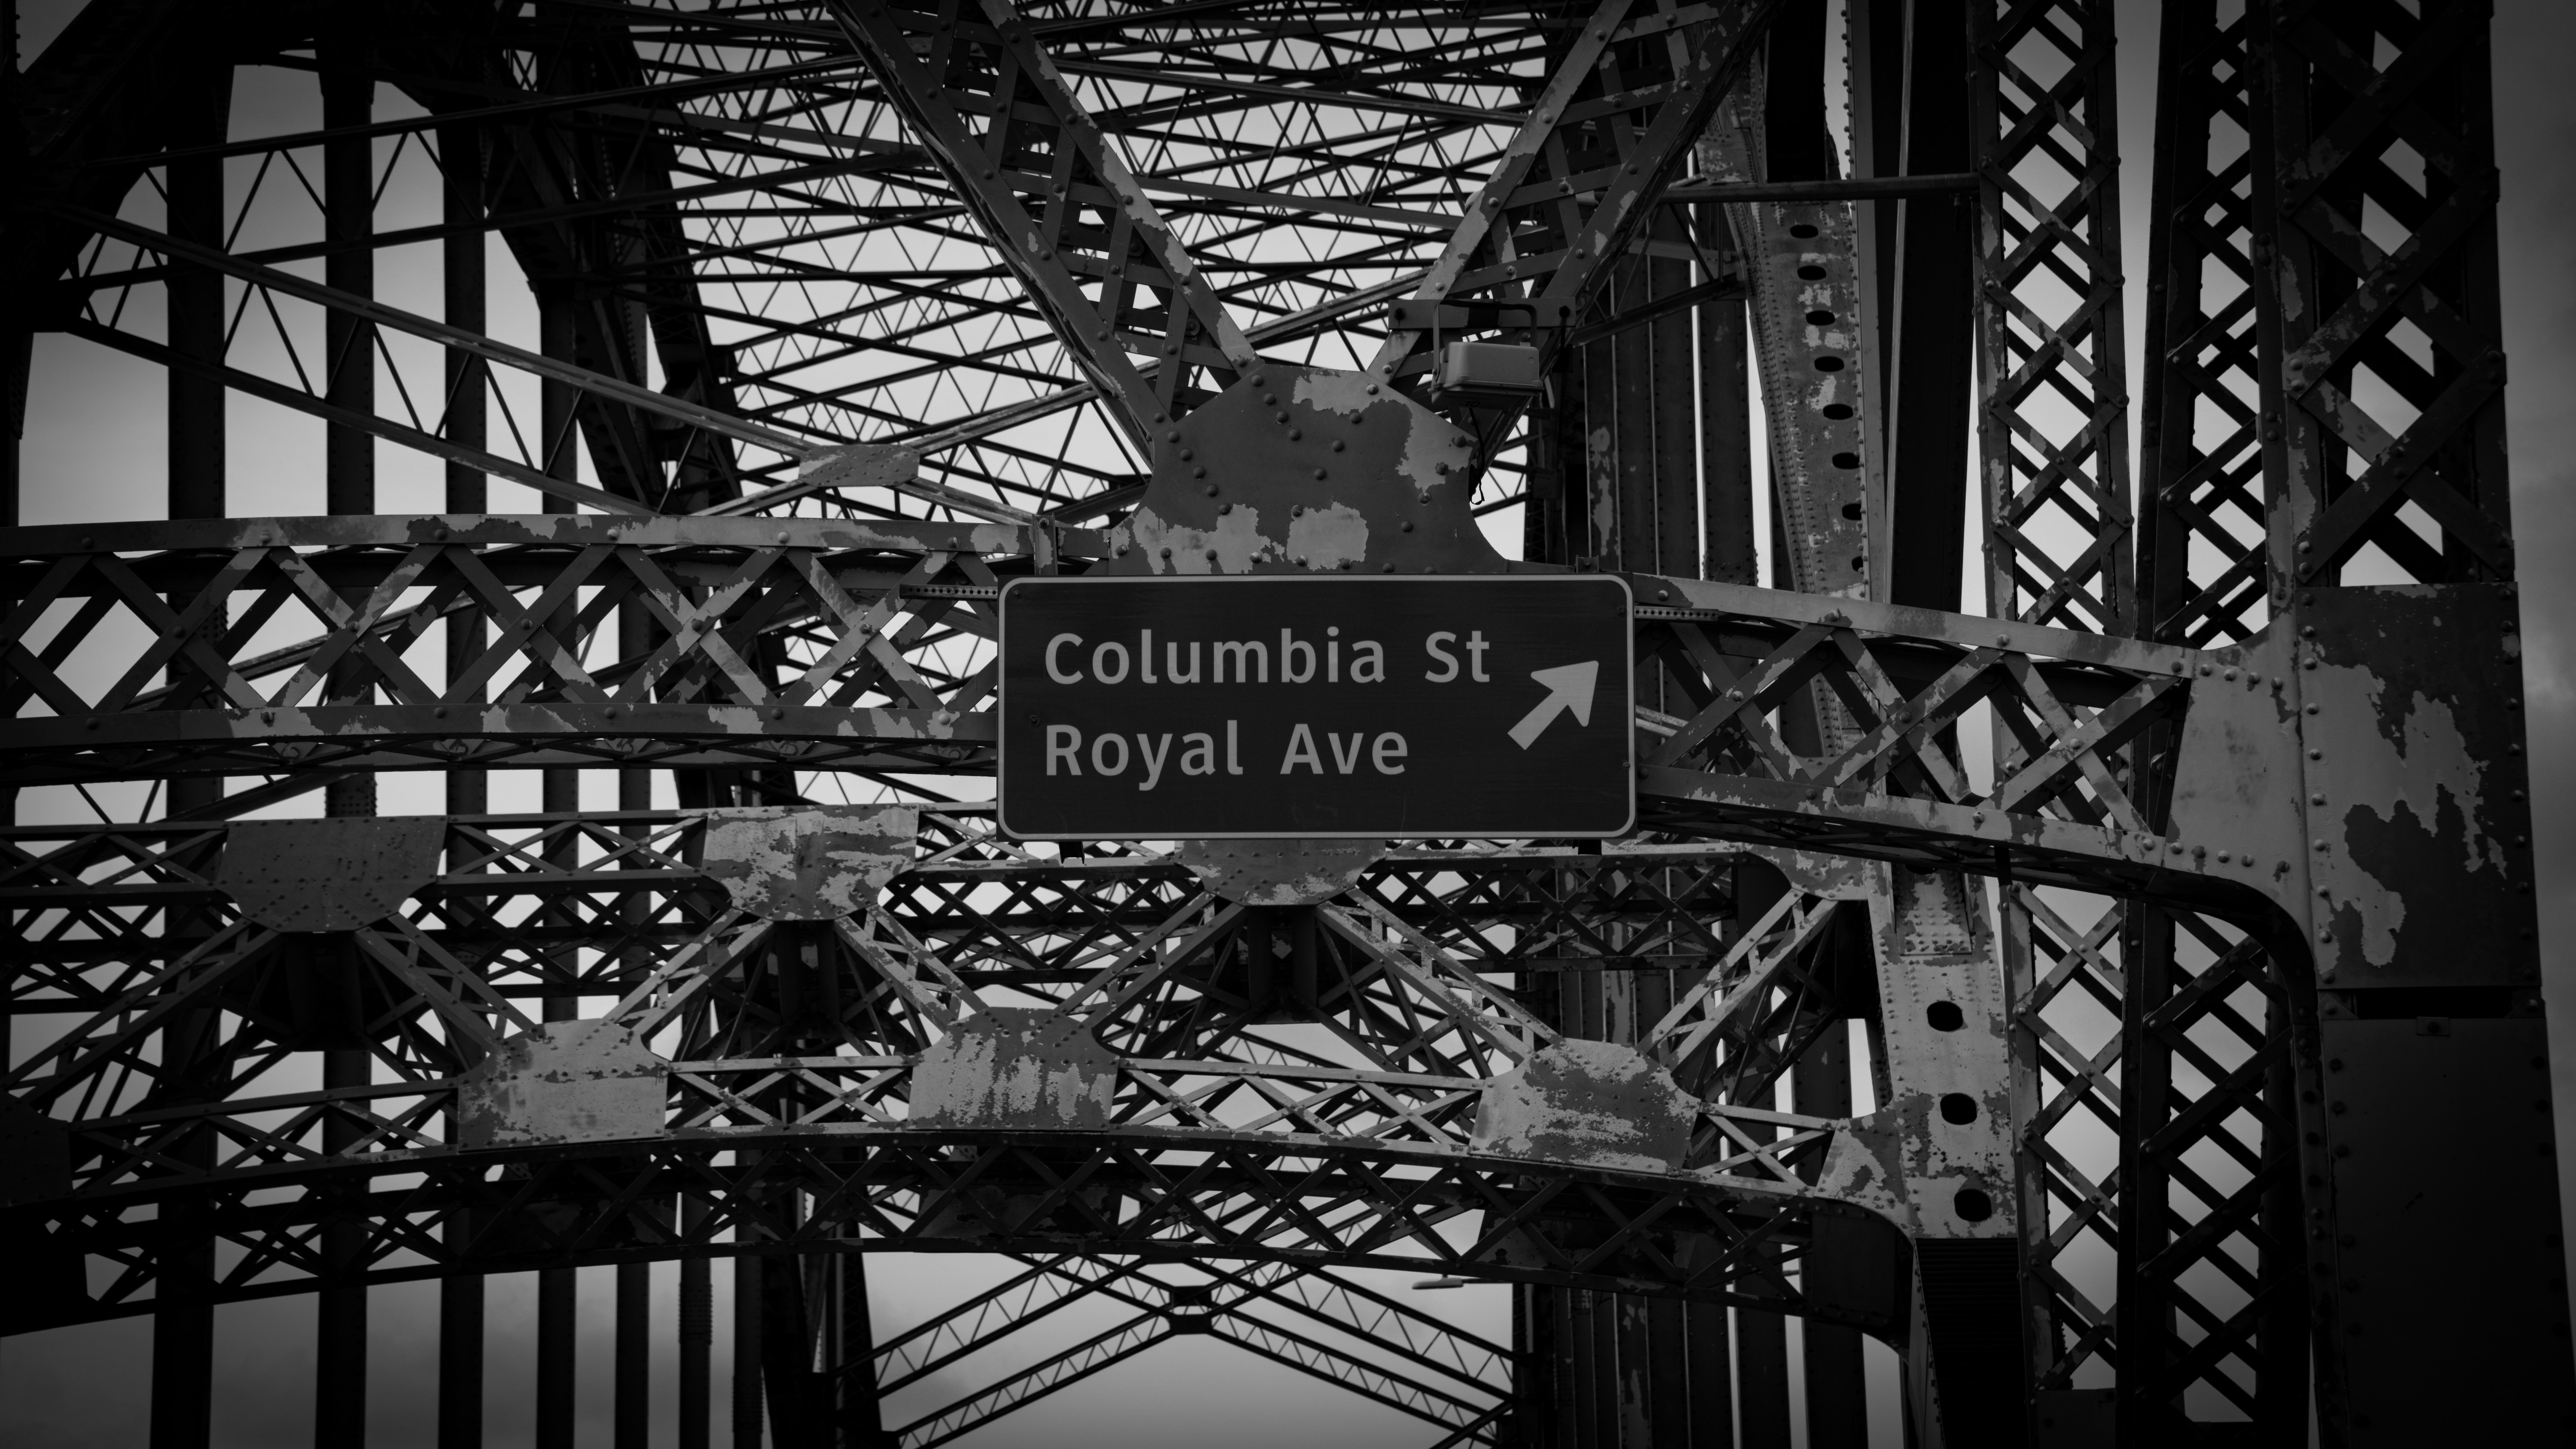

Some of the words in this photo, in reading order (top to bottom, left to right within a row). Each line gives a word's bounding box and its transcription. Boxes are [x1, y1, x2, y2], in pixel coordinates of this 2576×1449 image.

[1045, 626, 1385, 684] Columbia
[1425, 631, 1490, 682] St
[1047, 720, 1243, 791] Royal
[1280, 724, 1408, 775] Ave
